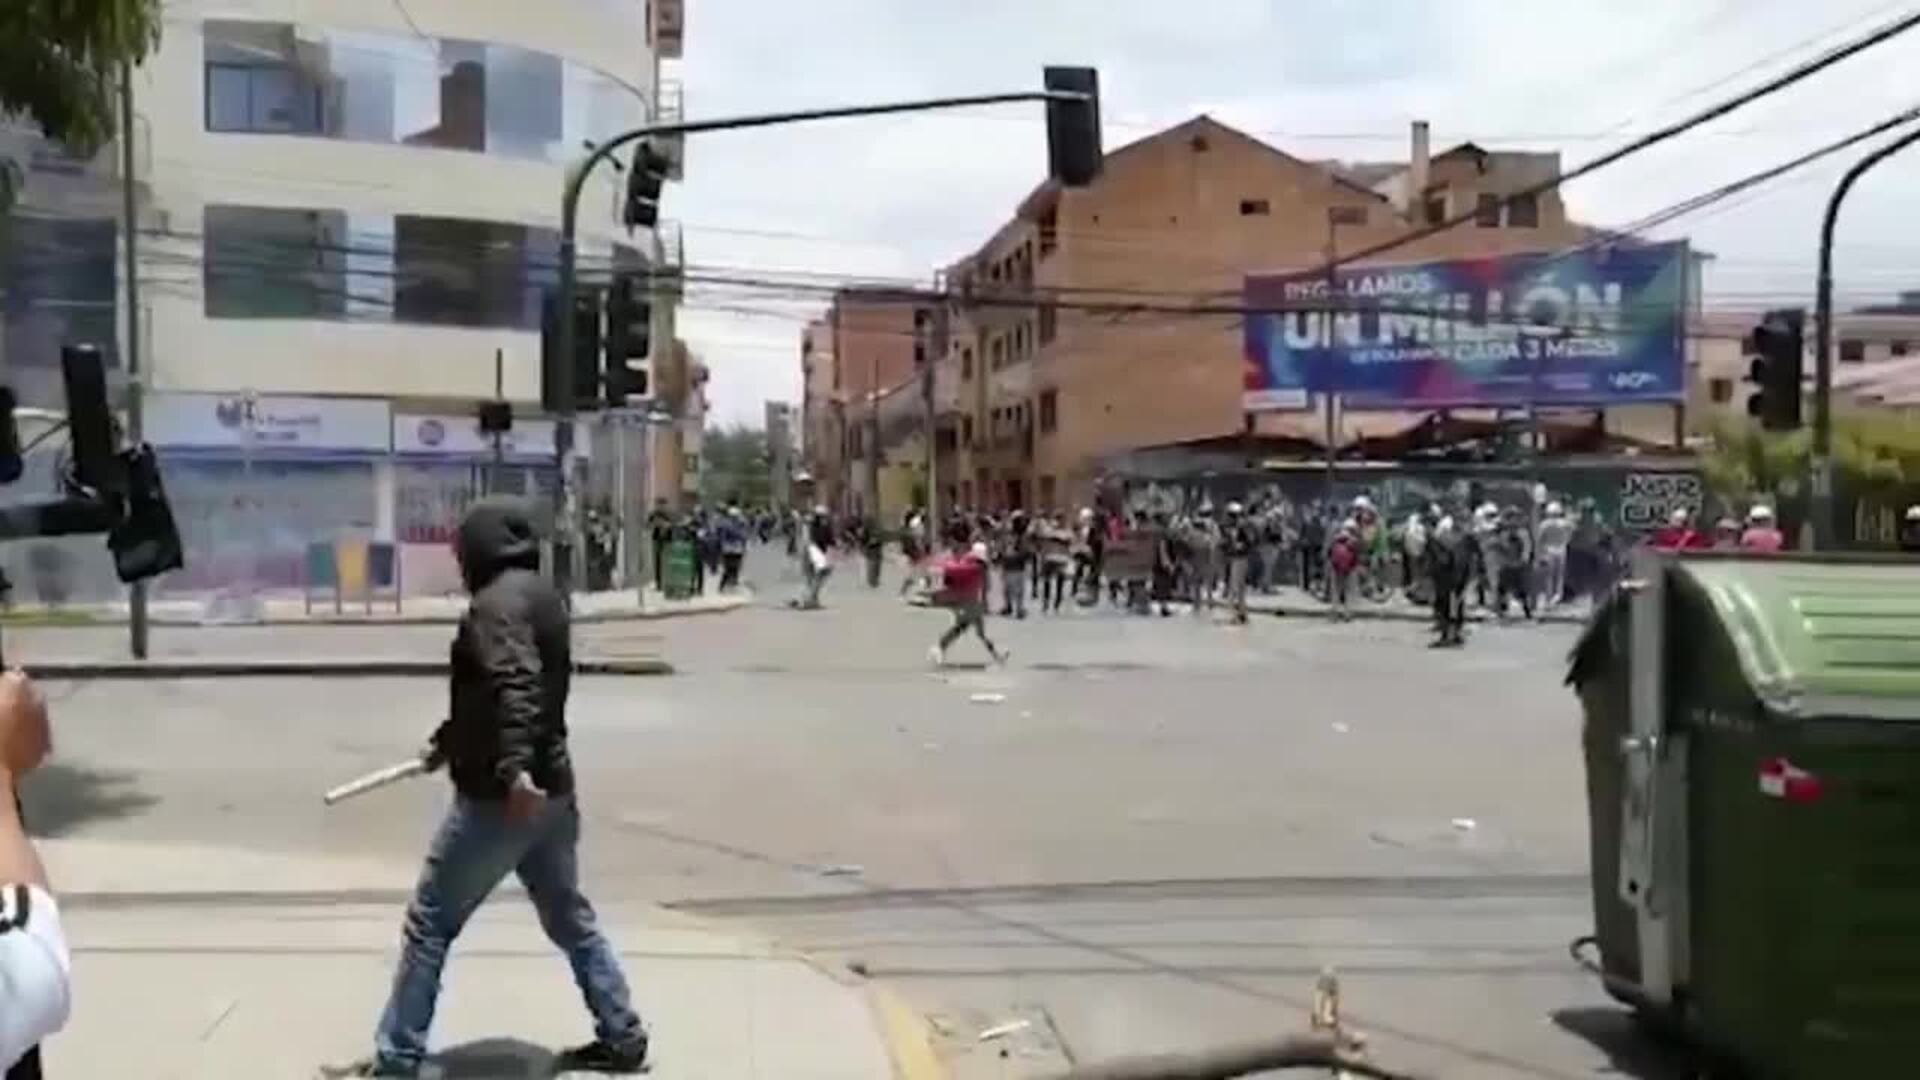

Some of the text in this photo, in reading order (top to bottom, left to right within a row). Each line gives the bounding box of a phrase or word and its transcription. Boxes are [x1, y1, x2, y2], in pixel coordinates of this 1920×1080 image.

[1284, 272, 1432, 300] REGLAMOS
[1455, 341, 1520, 362] CADA
[1525, 340, 1541, 359] 3
